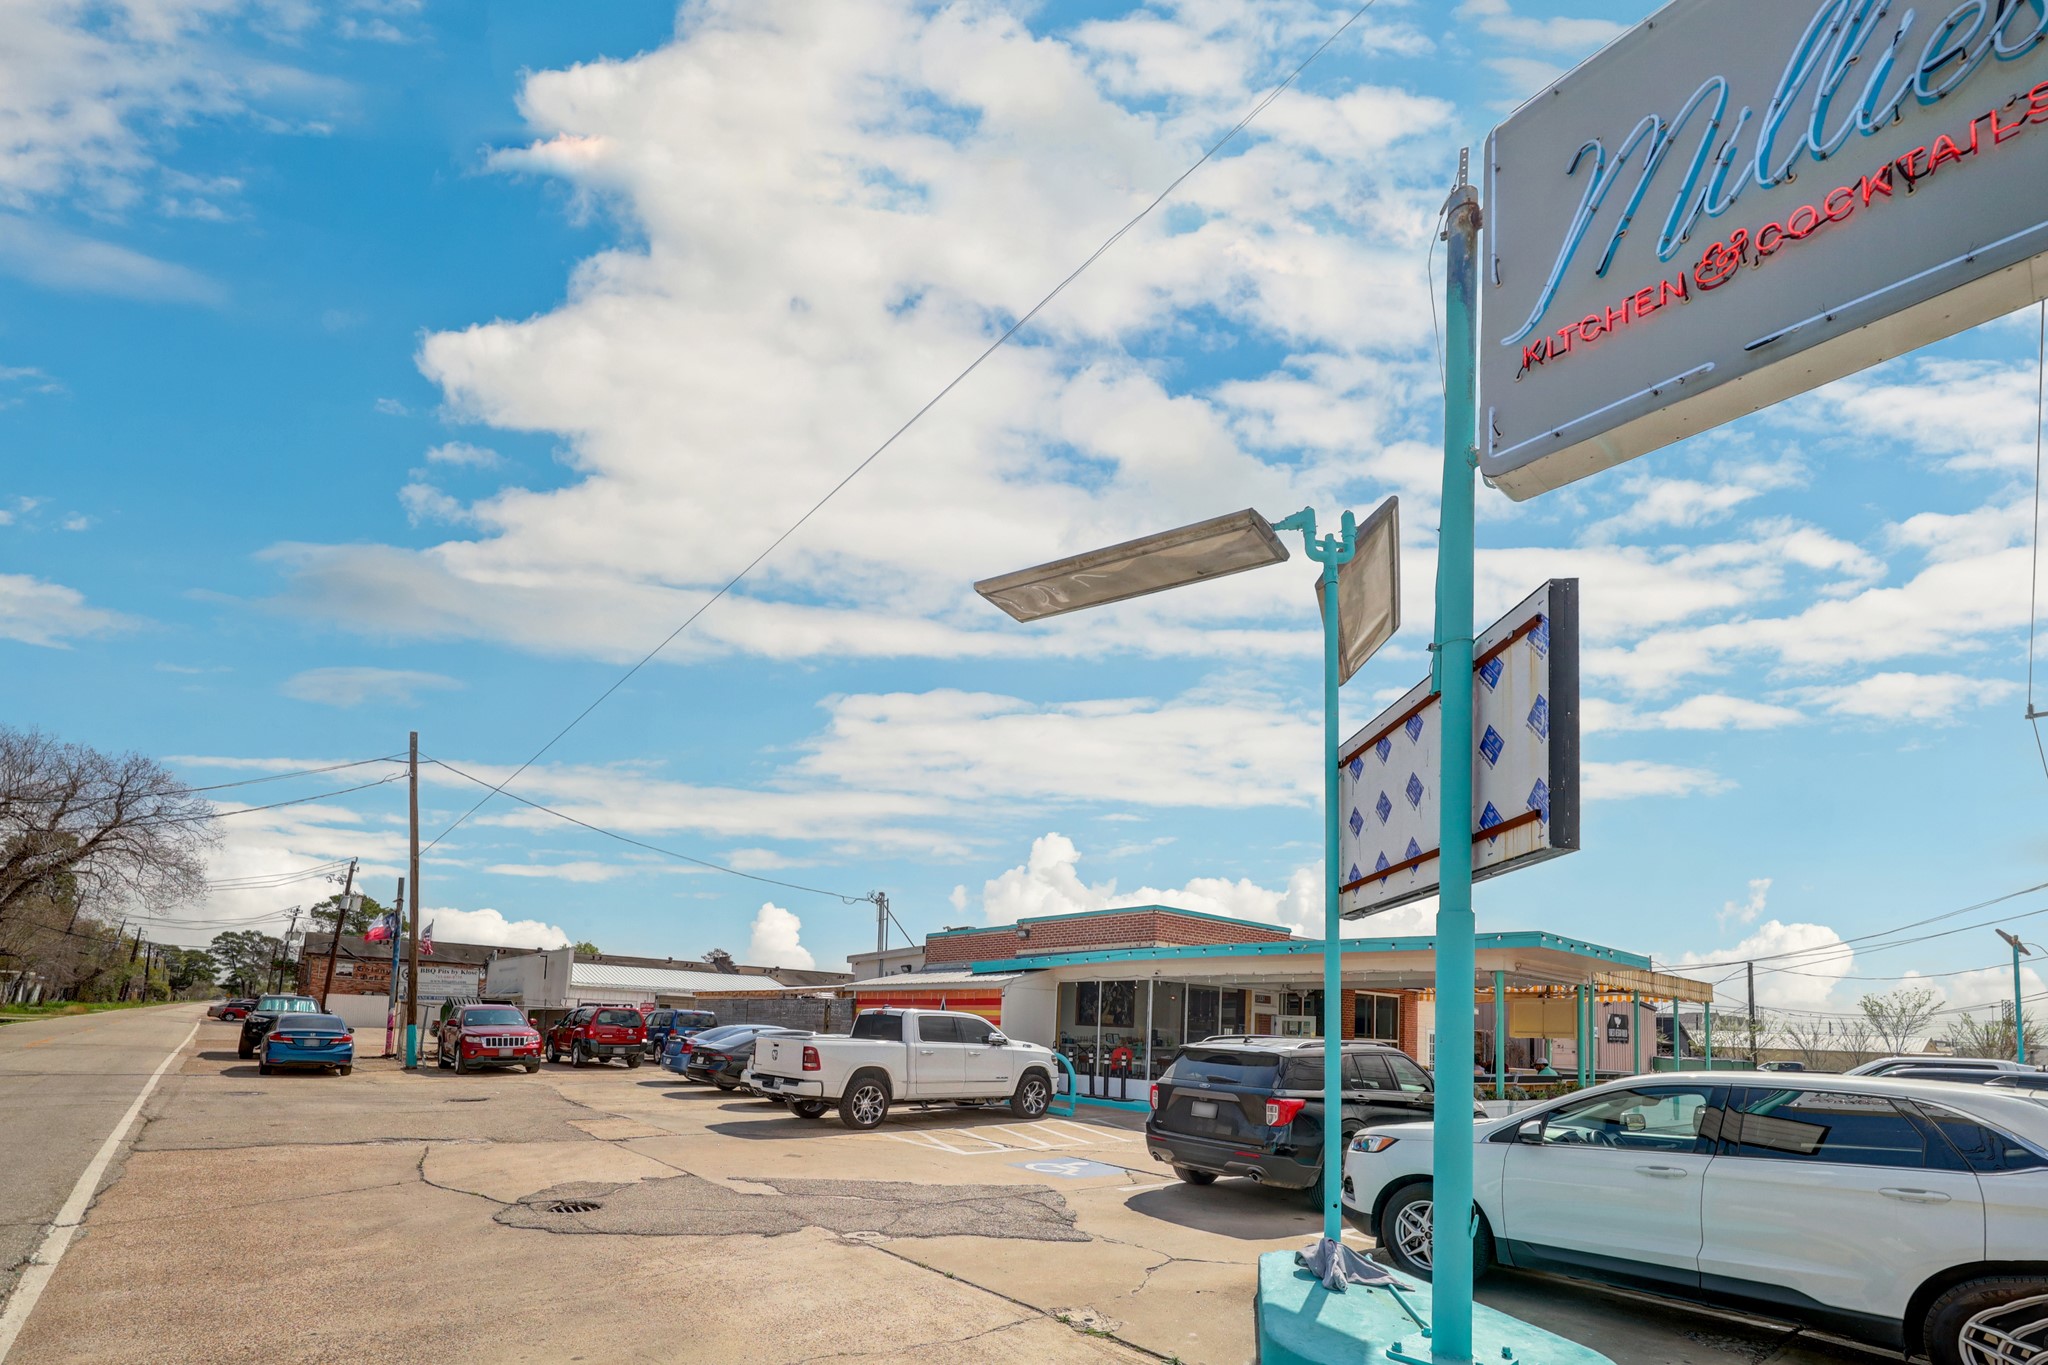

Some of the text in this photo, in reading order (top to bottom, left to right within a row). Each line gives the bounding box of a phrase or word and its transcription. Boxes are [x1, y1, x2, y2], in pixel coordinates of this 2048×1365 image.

[1520, 79, 2048, 371] KITCHEN & COCKTAILS
[420, 967, 437, 975] BBQ
